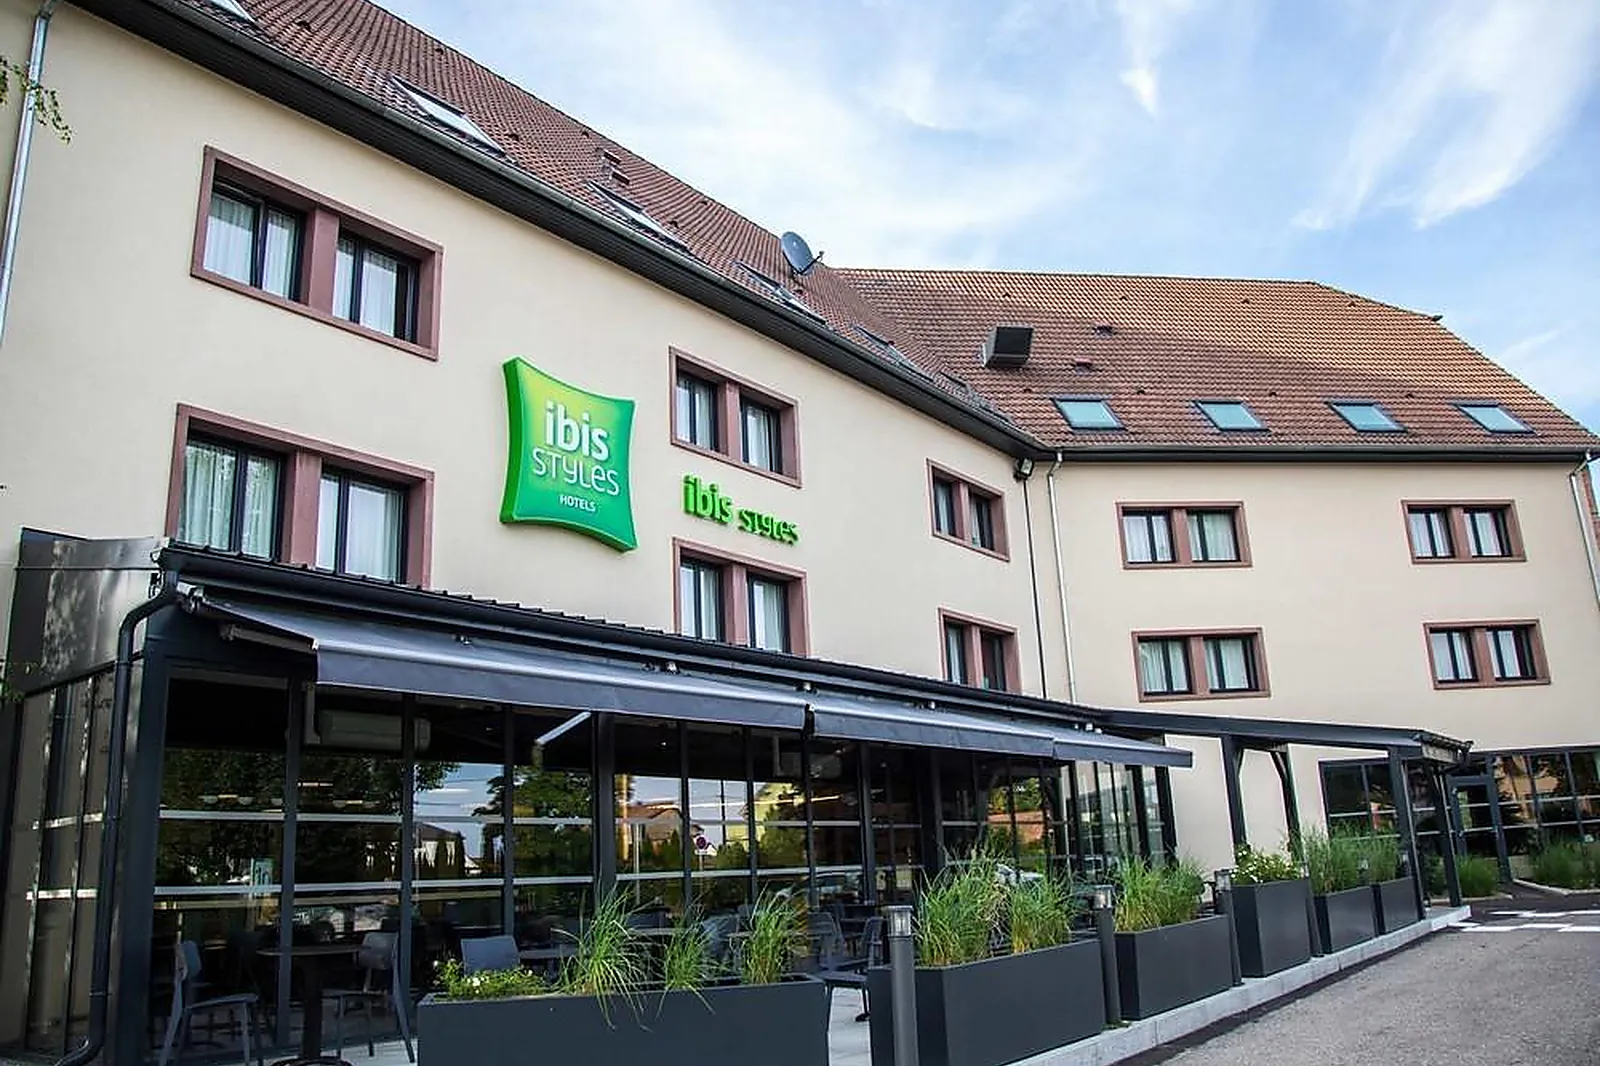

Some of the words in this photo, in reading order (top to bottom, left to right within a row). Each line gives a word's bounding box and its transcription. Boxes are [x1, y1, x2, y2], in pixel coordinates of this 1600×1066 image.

[545, 400, 609, 461] ibis
[559, 494, 597, 512] HOTELS
[683, 474, 732, 525] ibis
